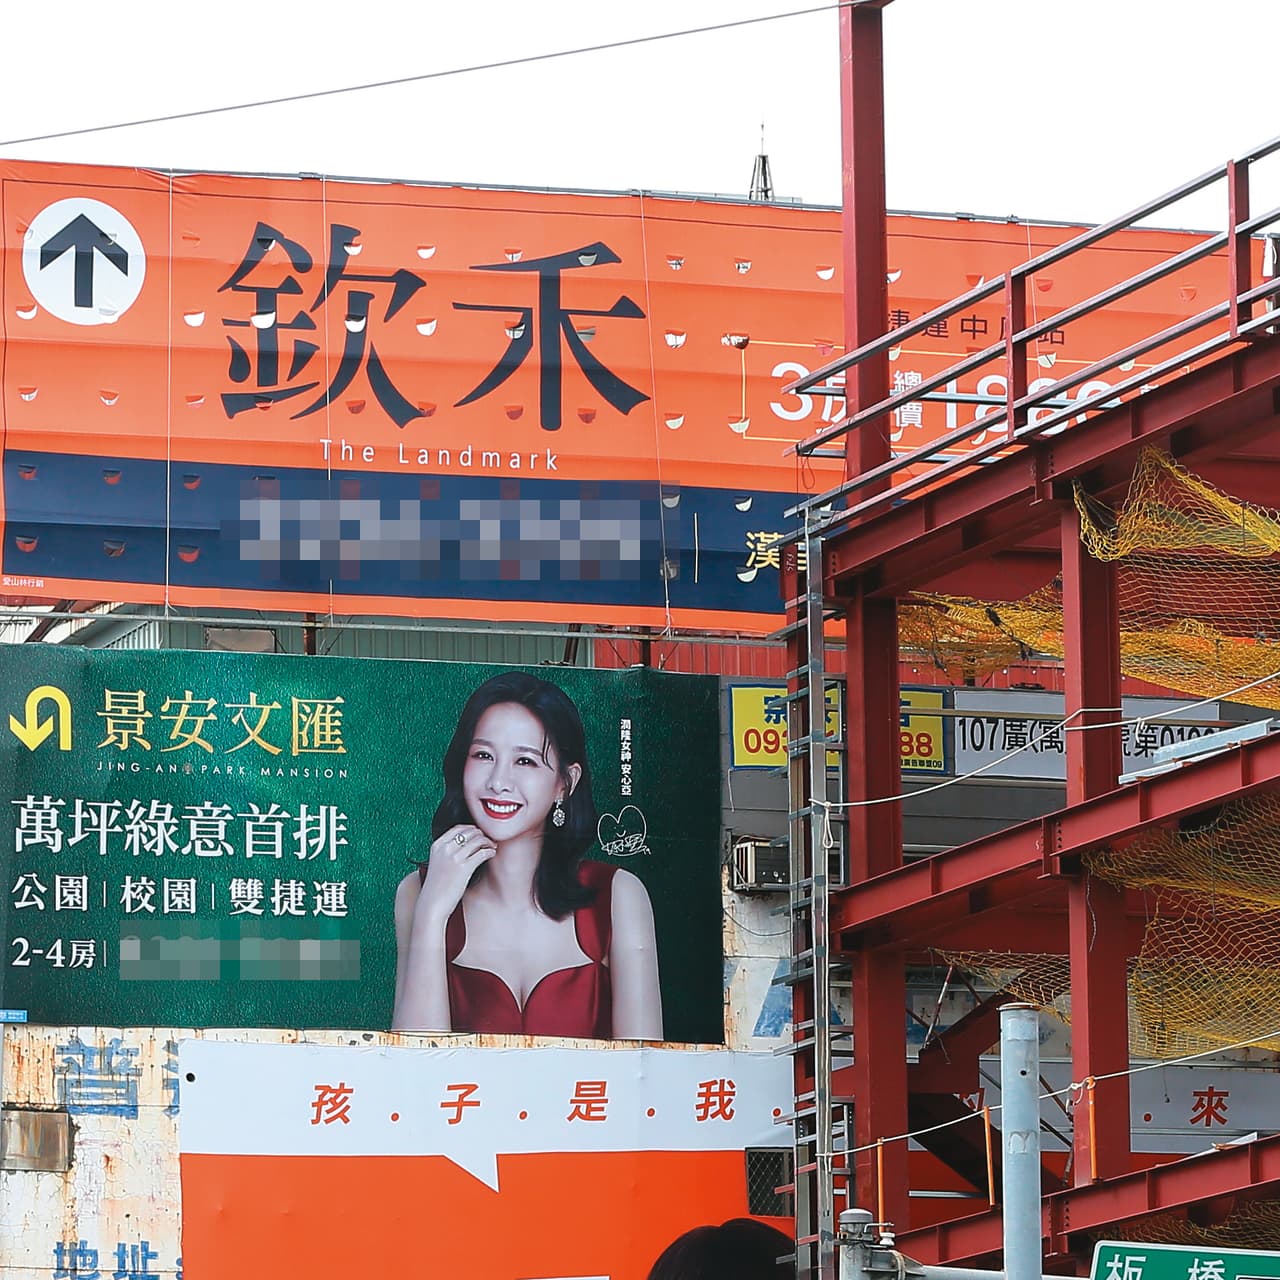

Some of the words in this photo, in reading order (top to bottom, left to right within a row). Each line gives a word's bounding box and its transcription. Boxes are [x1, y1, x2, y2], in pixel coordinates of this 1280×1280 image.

[217, 221, 649, 431] 欽禾
[321, 439, 377, 464] The
[399, 441, 560, 473] Landmark
[96, 690, 347, 757] 景安文匯
[97, 762, 177, 773] JING-AN
[201, 766, 246, 775] PARK
[261, 767, 348, 778] MANSION
[12, 794, 348, 861] 萬坪綠意首排
[12, 873, 89, 913] 公園
[120, 875, 198, 915] 校園
[228, 877, 348, 918] 雙捷運
[11, 937, 96, 969] 2-4房
[1191, 1086, 1228, 1128] 來
